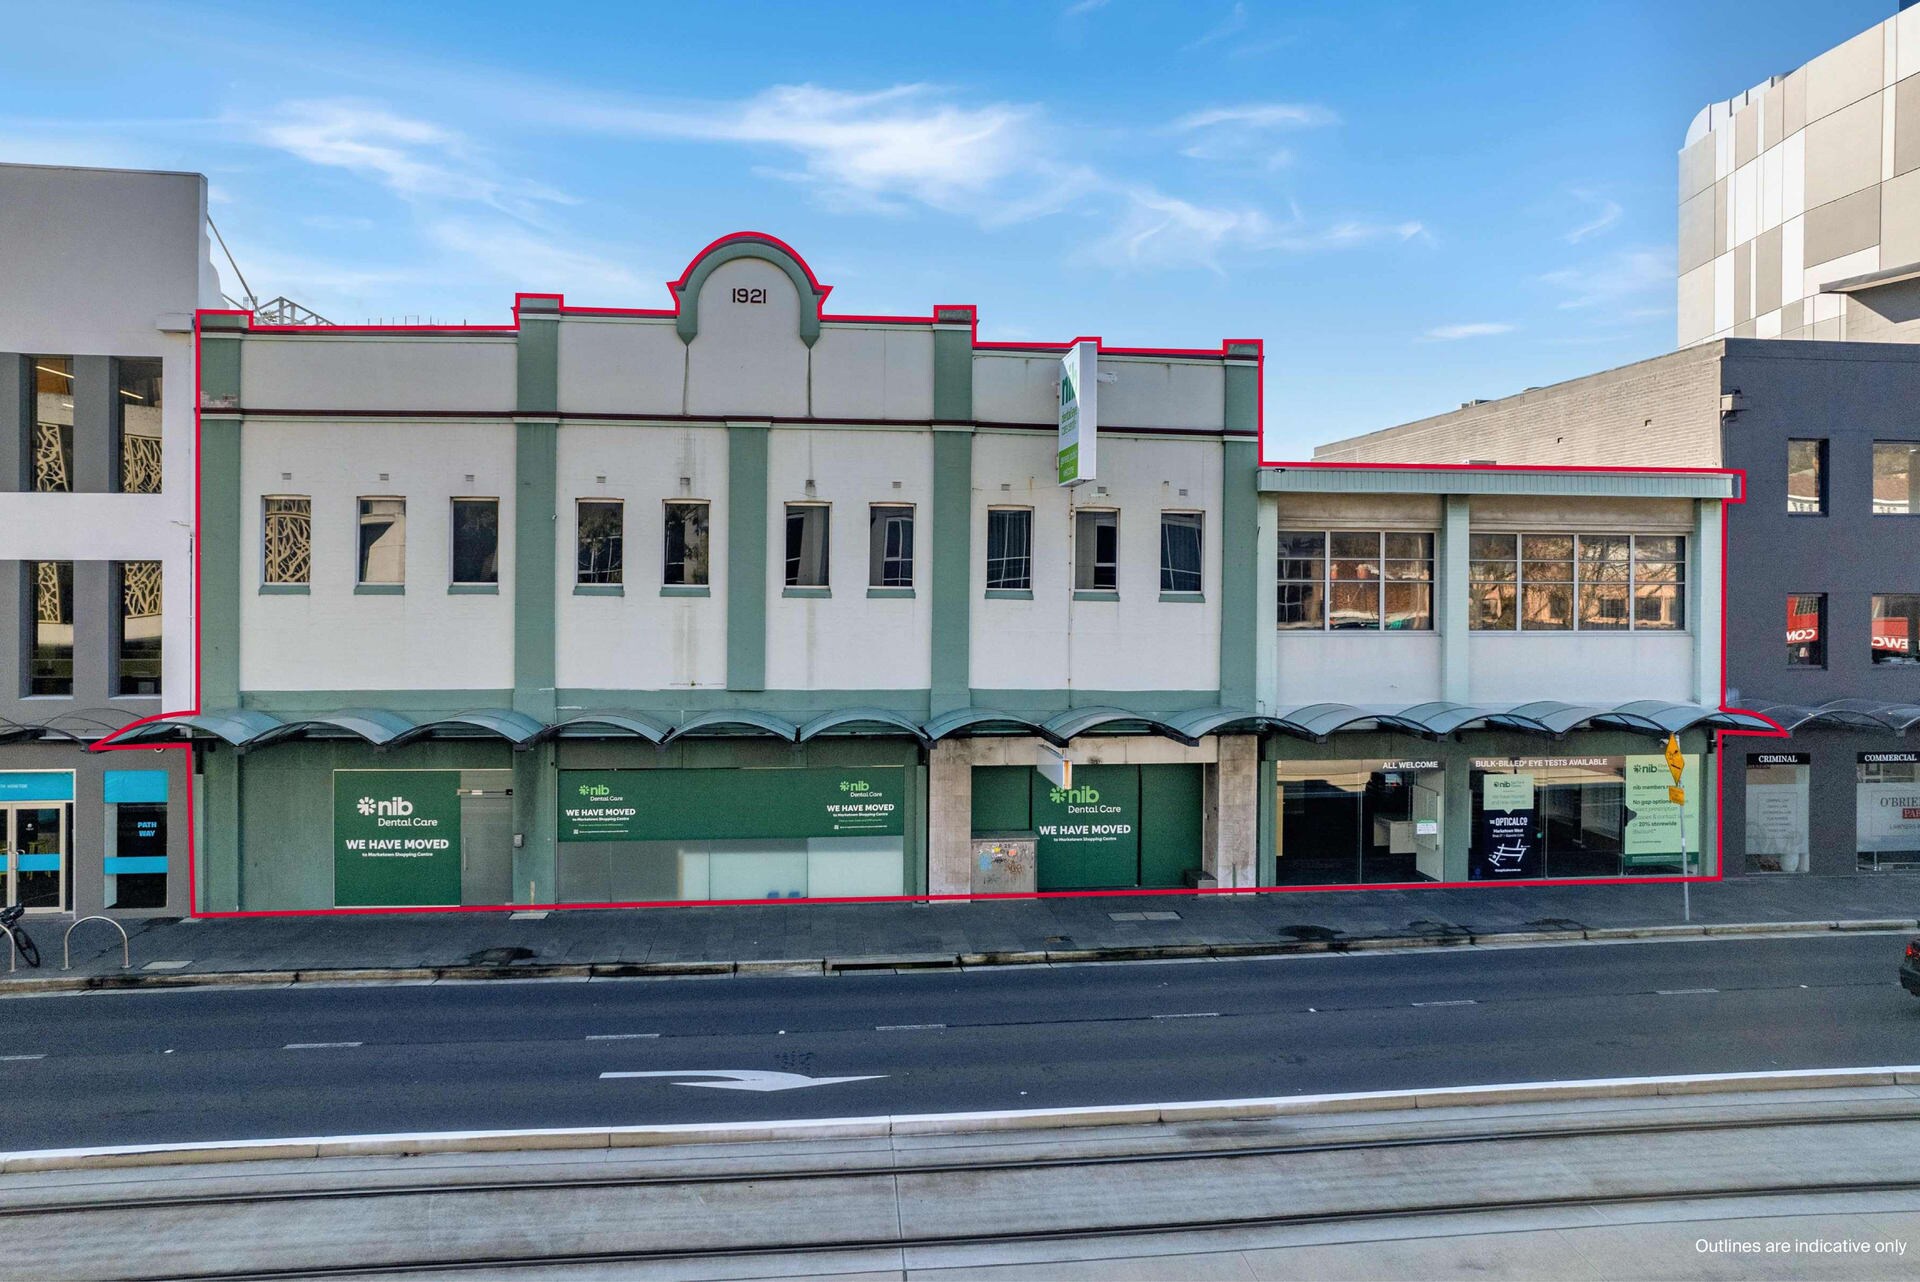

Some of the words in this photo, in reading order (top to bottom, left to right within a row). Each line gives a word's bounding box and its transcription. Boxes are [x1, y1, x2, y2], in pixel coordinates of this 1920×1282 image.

[732, 288, 766, 304] 1921
[1568, 758, 1608, 766] AVAILABLE
[1758, 755, 1797, 763] CRIMINAL
[1865, 754, 1917, 762] COMMERCIAL
[1382, 761, 1398, 769] ALL
[1642, 764, 1658, 773] nib
[590, 784, 610, 795] nib
[850, 781, 869, 791] nib
[1068, 786, 1099, 803] nib
[378, 796, 413, 816] nib
[1880, 797, 1920, 808] O'BRIE
[606, 808, 636, 816] MOVED
[1100, 805, 1121, 813] Care
[378, 818, 412, 826] Dental
[413, 817, 438, 826] Care
[1039, 826, 1057, 835] WE
[1060, 825, 1089, 834] HAVE
[1092, 825, 1131, 834] MOVED
[345, 840, 366, 849] WE
[368, 840, 401, 849] HAVE
[404, 839, 449, 849] MOVED
